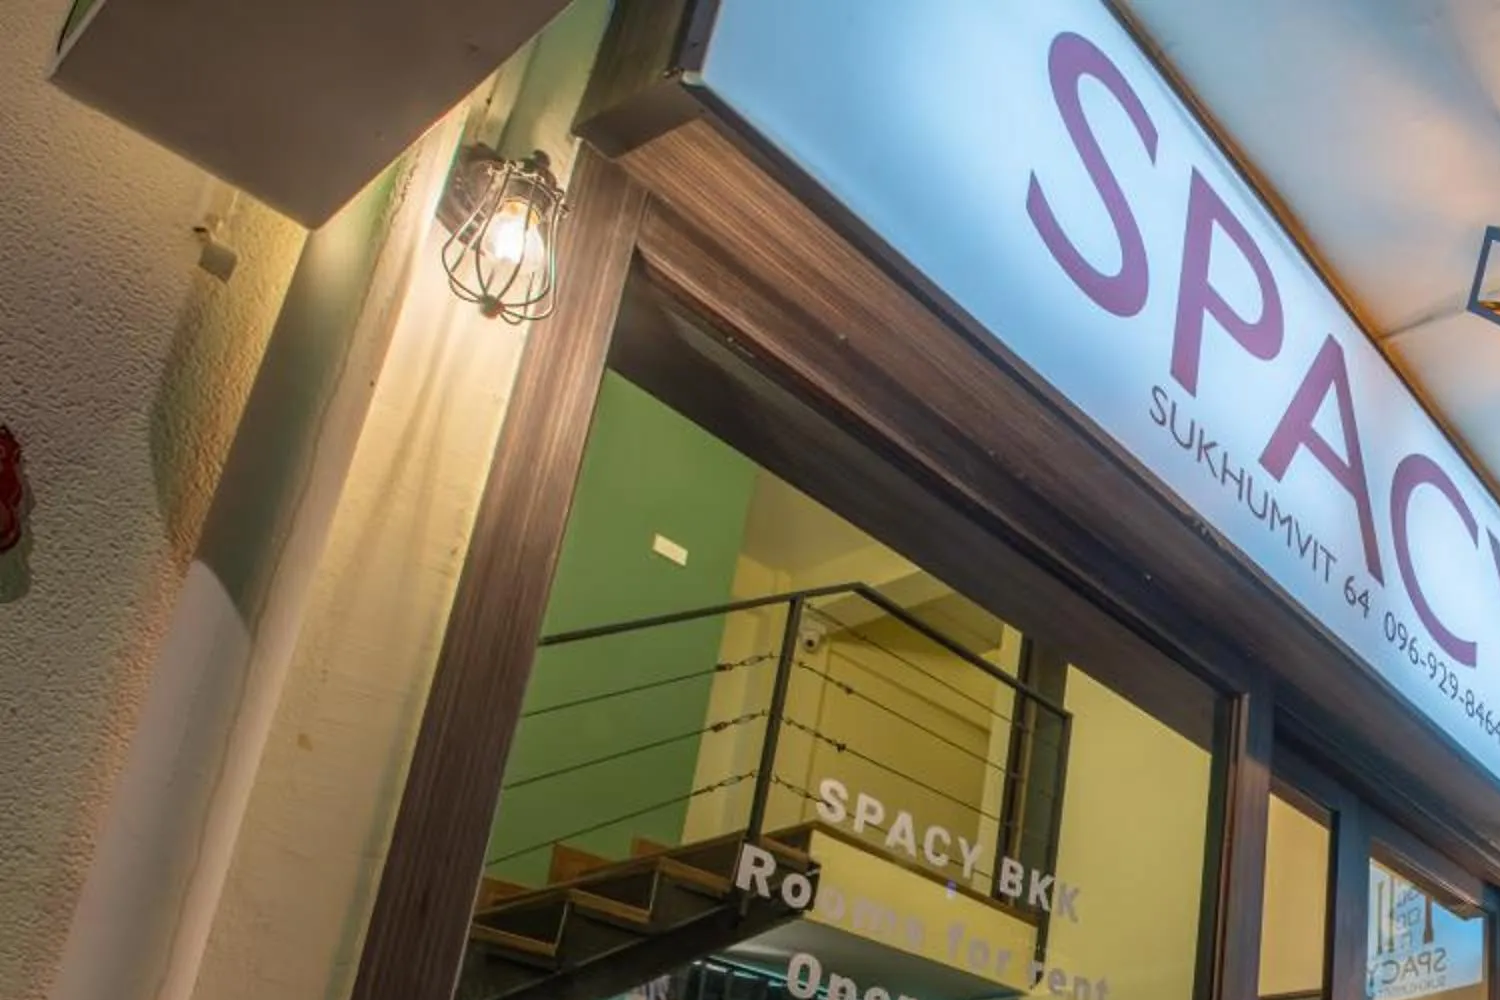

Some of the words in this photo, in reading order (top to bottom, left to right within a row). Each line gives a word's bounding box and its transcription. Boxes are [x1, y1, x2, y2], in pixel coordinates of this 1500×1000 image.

[1149, 385, 1338, 583] SUKHUMVIT
[1344, 576, 1371, 619] 64
[816, 778, 984, 880] SPACY
[1000, 856, 1080, 924] BKK
